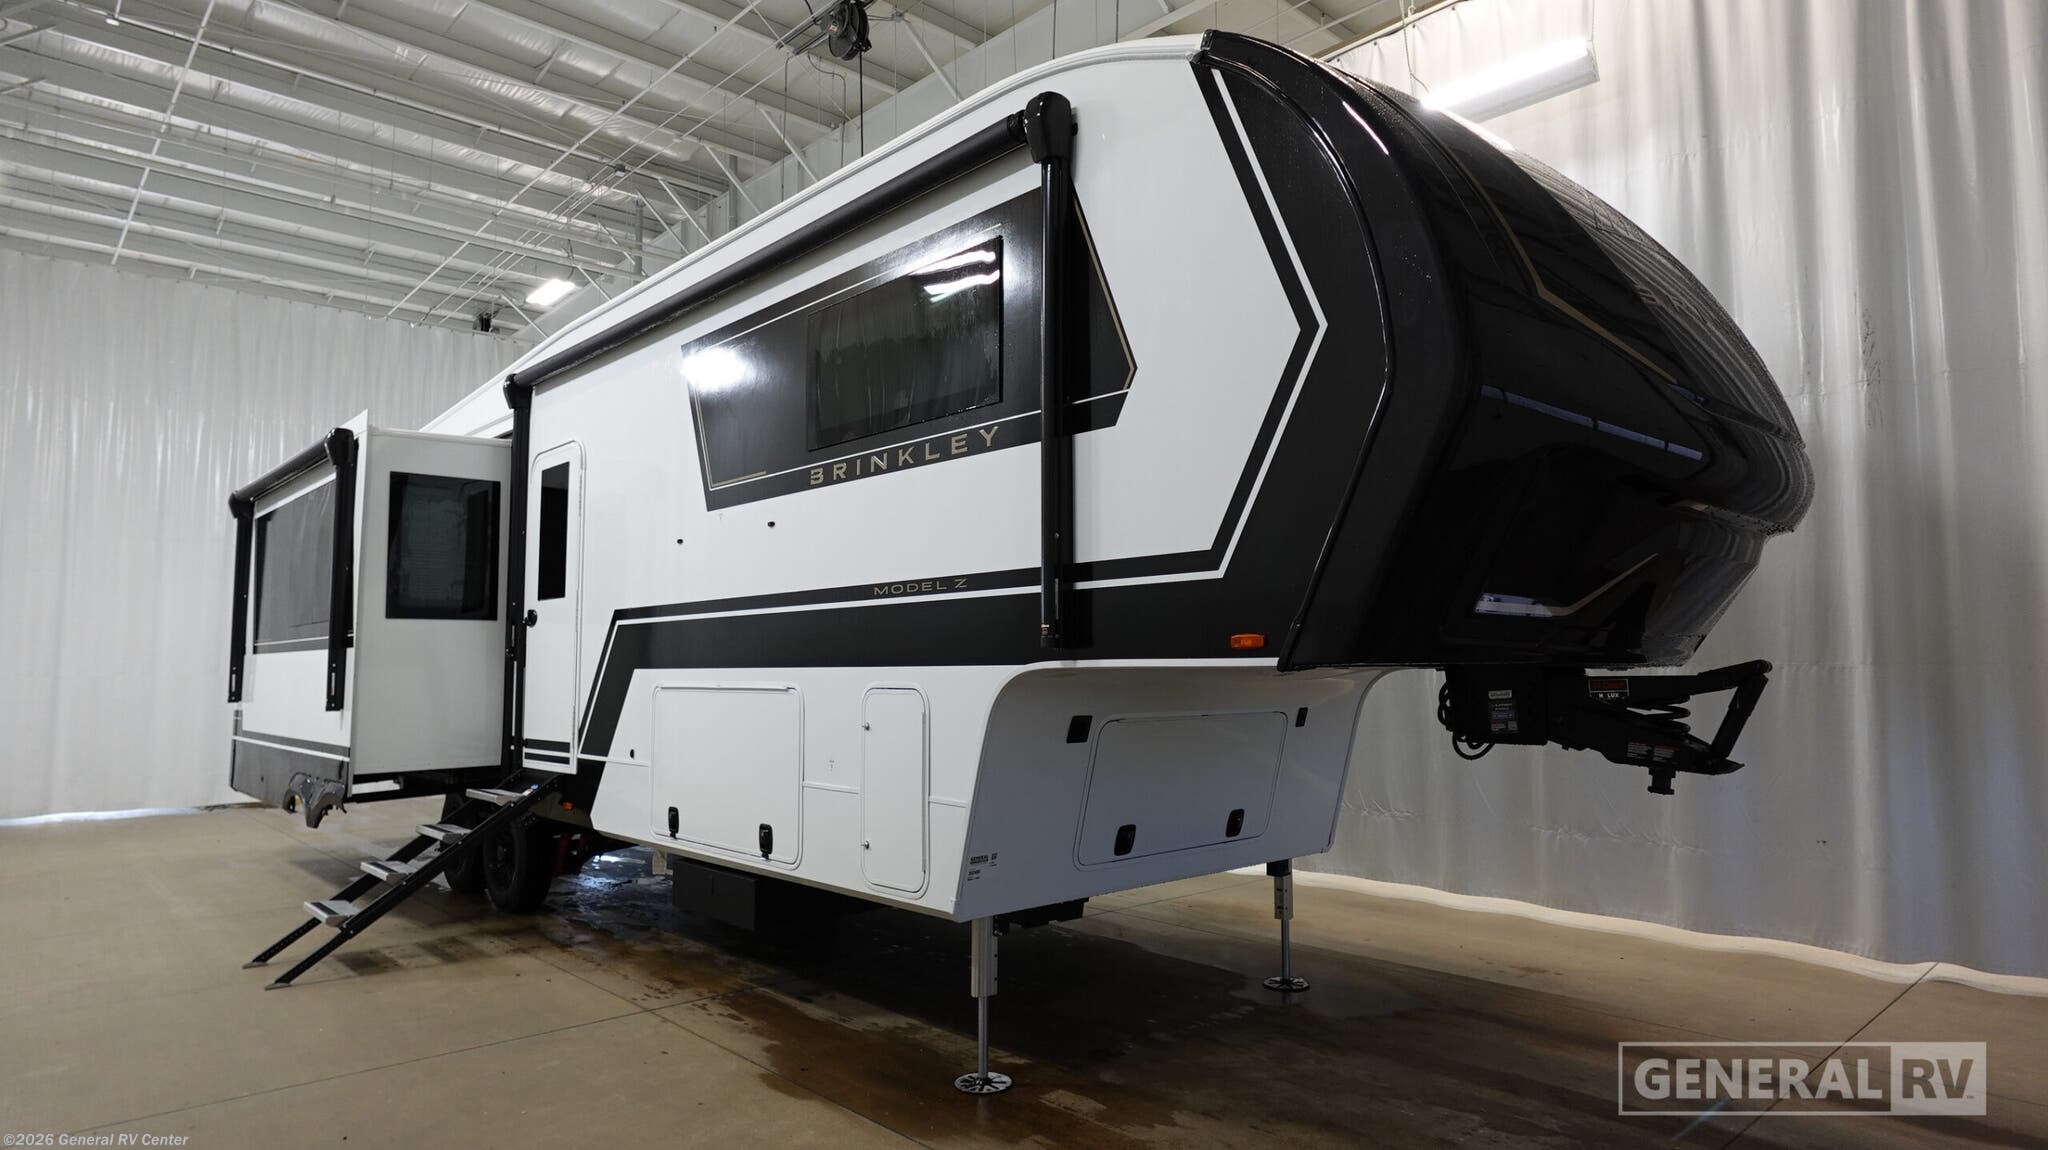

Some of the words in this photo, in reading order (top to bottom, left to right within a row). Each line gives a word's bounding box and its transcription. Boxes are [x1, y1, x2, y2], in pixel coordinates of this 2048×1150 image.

[810, 426, 999, 485] BRINKLEY
[873, 581, 947, 596] MODEL
[954, 578, 968, 588] Z
